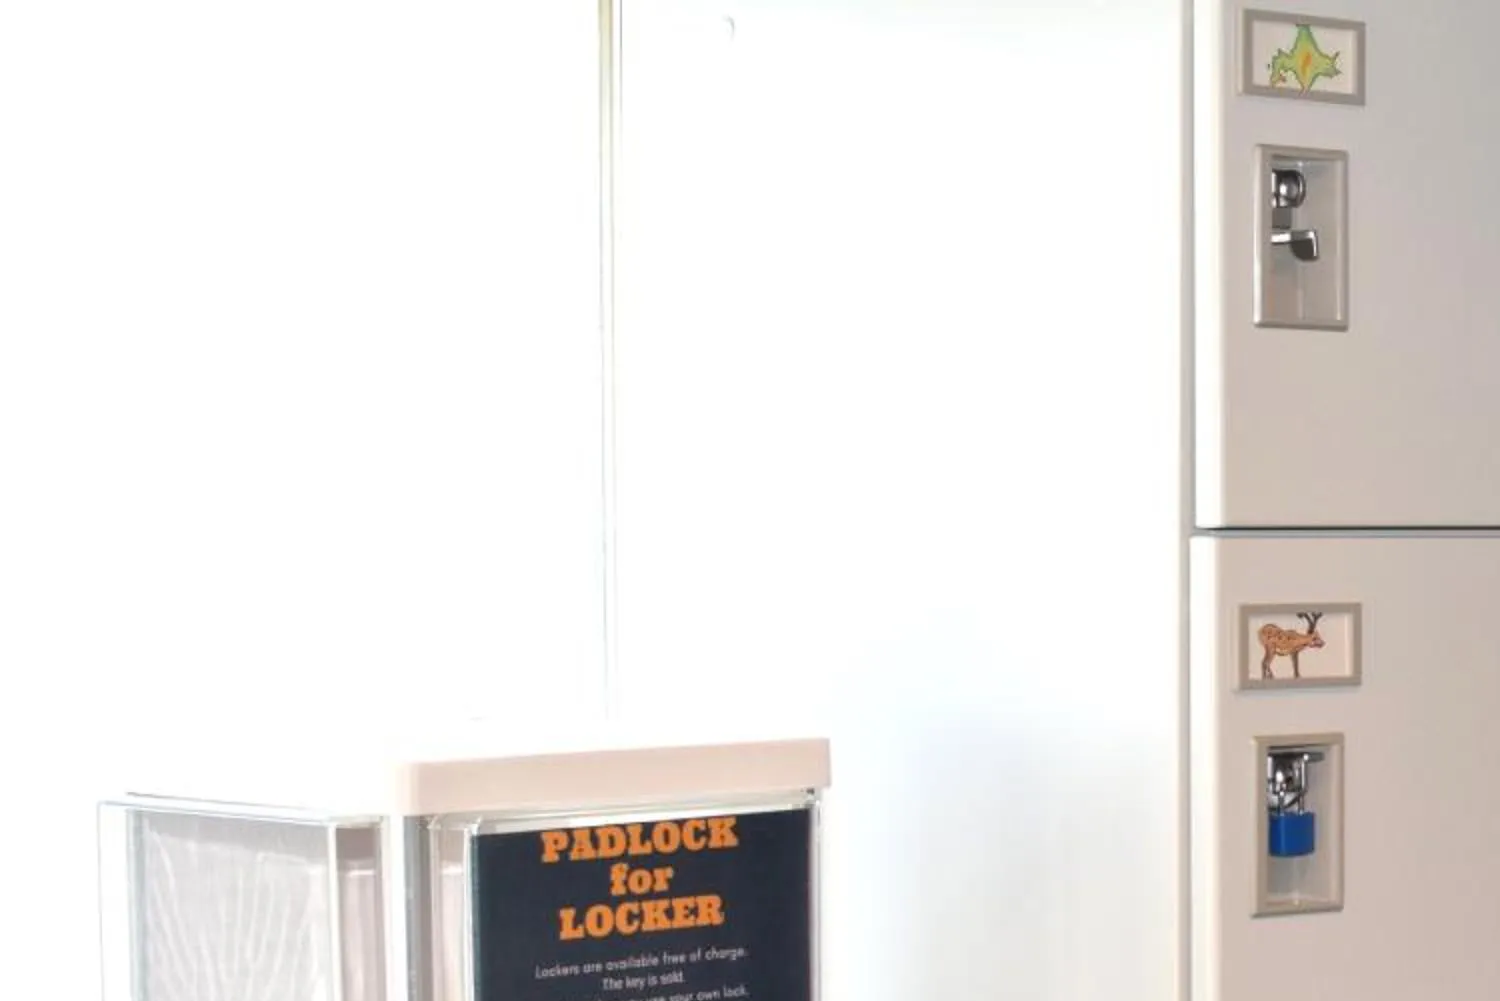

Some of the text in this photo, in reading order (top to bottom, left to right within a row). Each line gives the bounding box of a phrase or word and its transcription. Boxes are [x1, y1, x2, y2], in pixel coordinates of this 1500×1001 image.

[541, 816, 739, 863] PADLOCK
[610, 862, 674, 896] for
[559, 894, 725, 940] LOCKER
[535, 964, 580, 979] Lockers
[583, 962, 603, 974] are
[606, 954, 659, 971] available
[663, 951, 686, 966] free
[689, 948, 702, 963] of
[602, 976, 623, 991] The
[626, 974, 646, 991] key
[647, 973, 658, 987] is
[696, 990, 721, 1001] own
